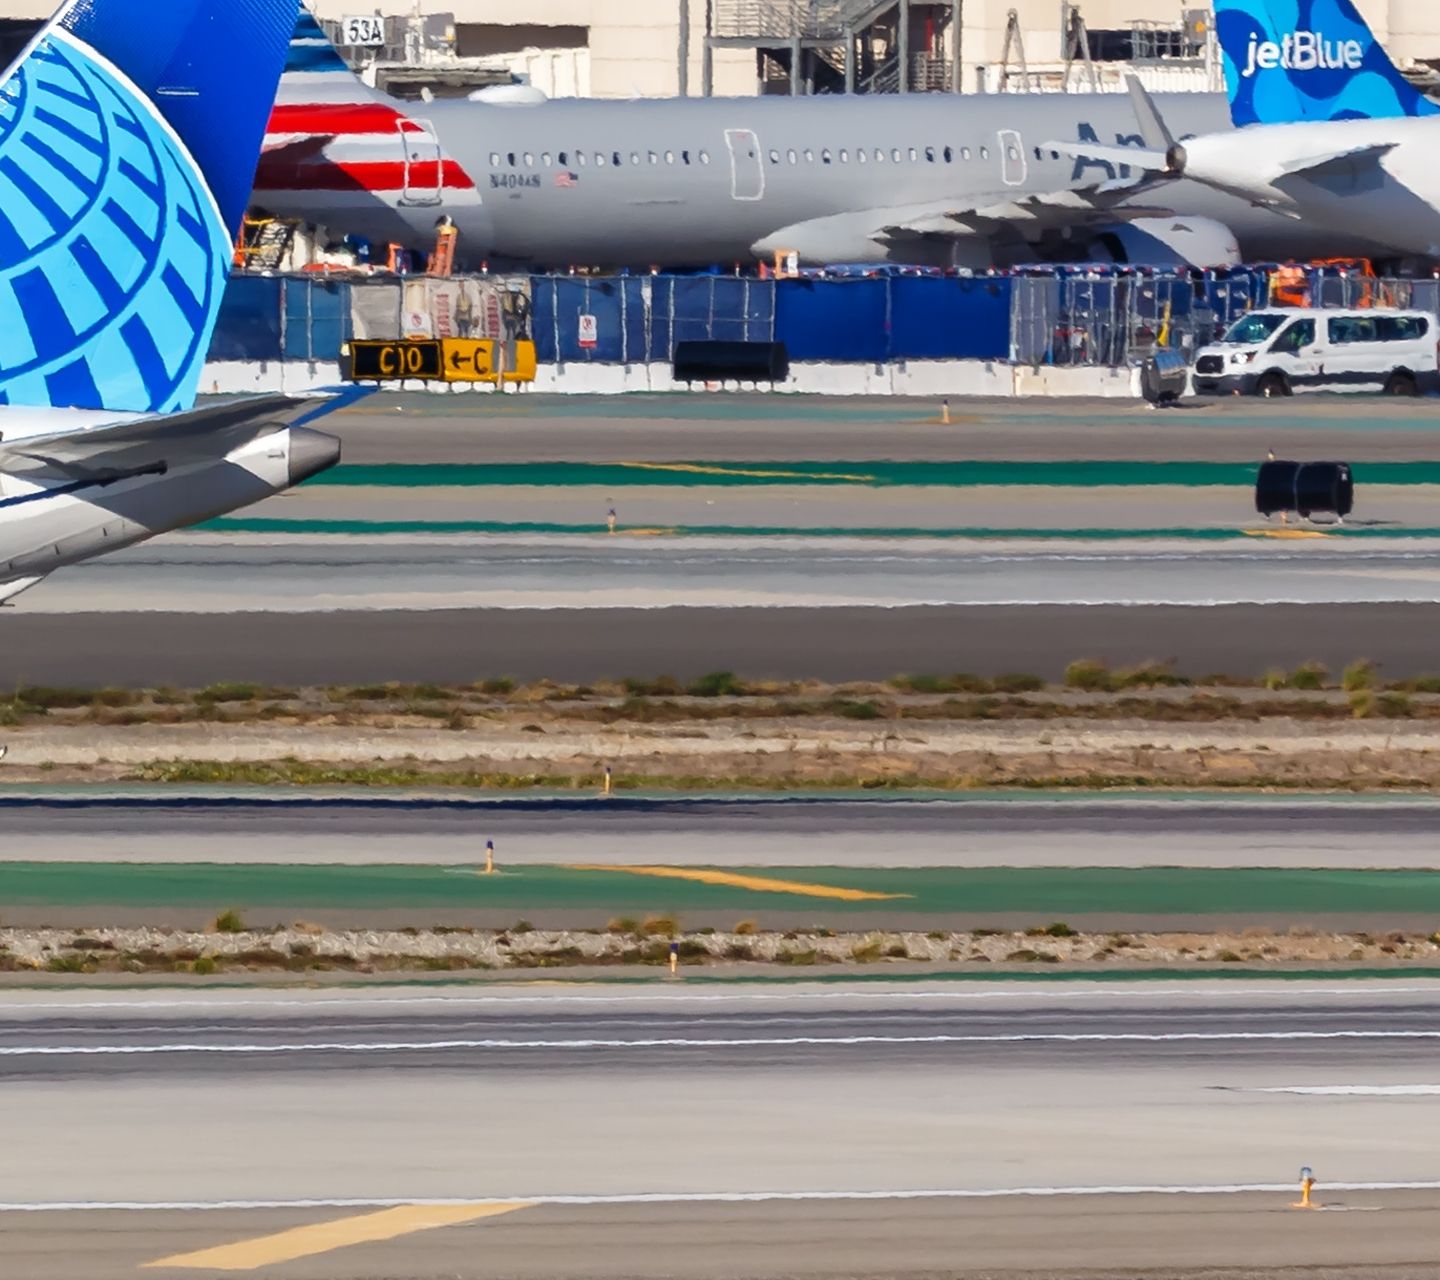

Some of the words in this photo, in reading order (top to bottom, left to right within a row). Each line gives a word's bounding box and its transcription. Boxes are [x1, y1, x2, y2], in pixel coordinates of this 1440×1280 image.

[348, 19, 383, 43] 53A
[1241, 30, 1364, 78] jetBlue
[379, 346, 423, 375] C10
